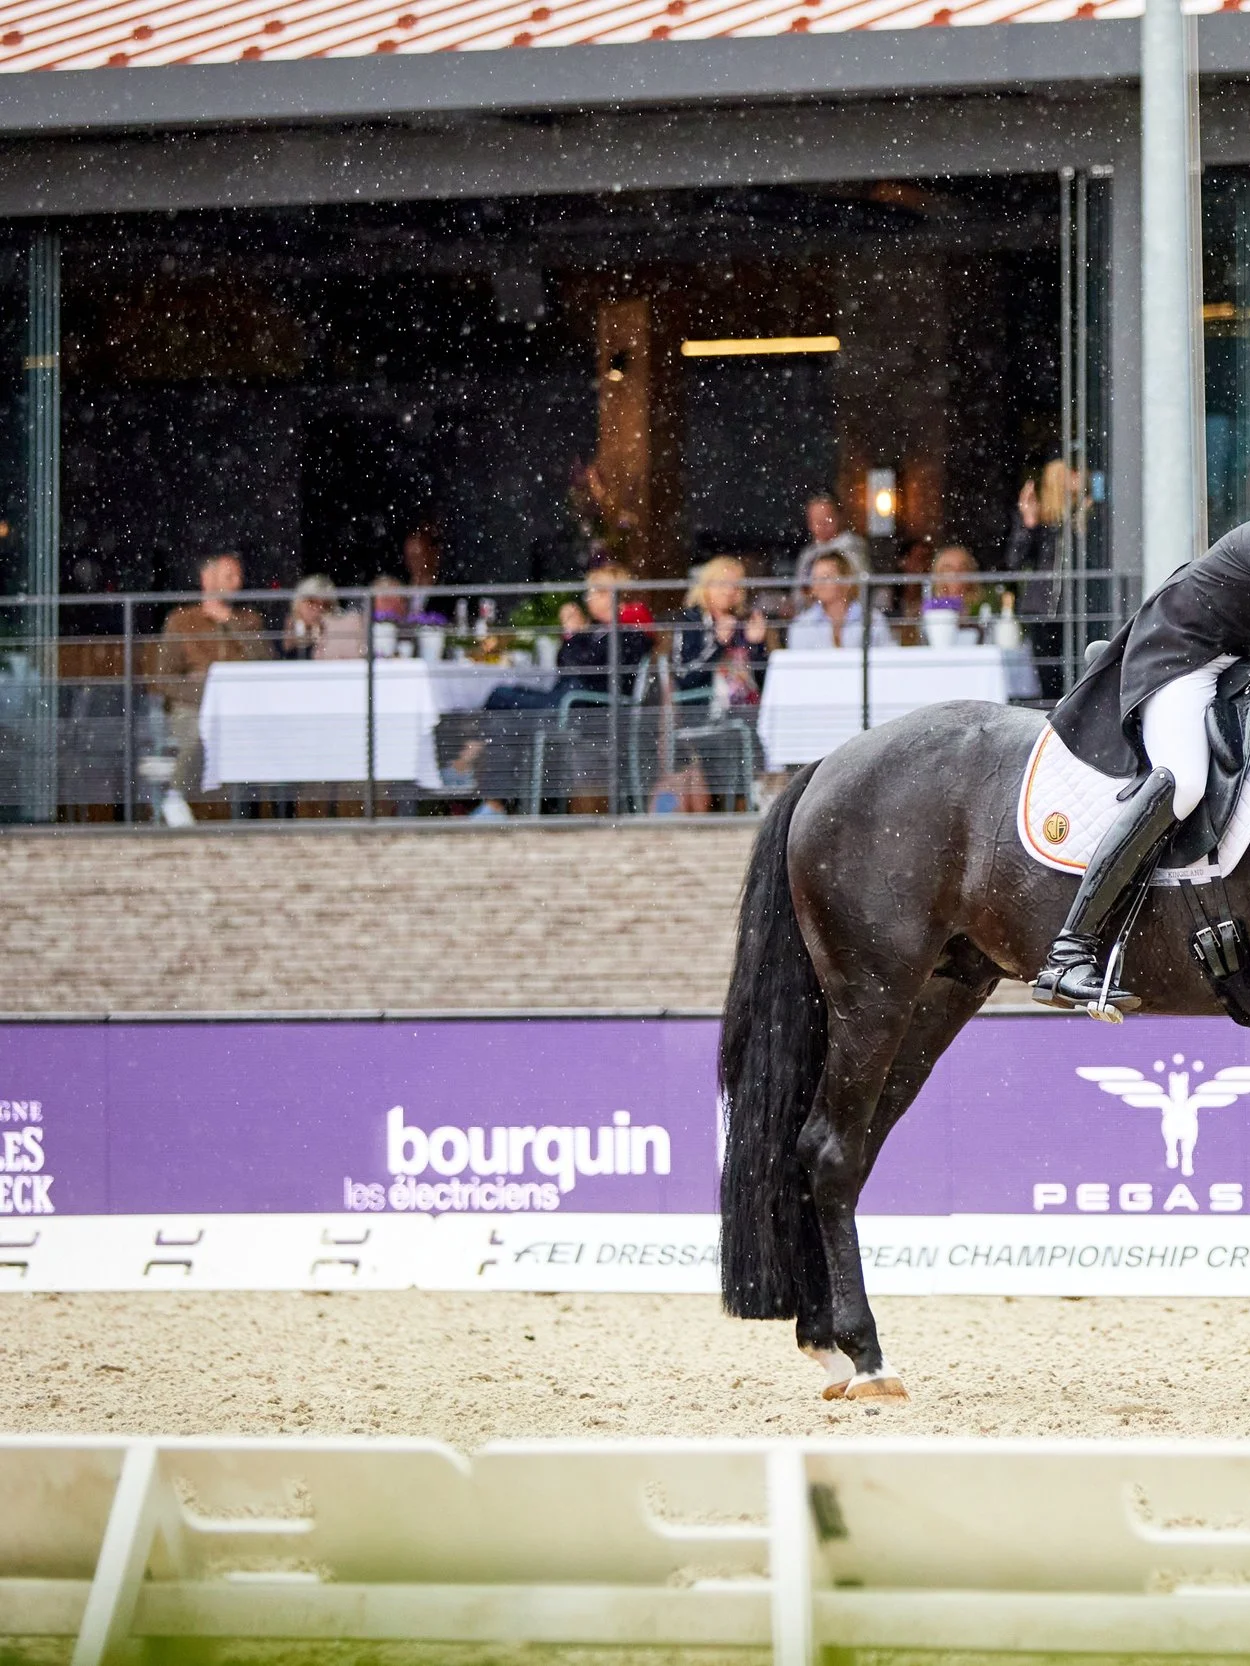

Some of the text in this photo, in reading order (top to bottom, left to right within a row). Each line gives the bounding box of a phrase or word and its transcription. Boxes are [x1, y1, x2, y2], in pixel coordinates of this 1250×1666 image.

[387, 1105, 671, 1193] bourquin
[343, 1174, 560, 1211] les électriciens
[513, 1241, 586, 1265] FEI
[595, 1243, 719, 1267] DRESSA
[859, 1244, 939, 1268] PEAN
[948, 1244, 1198, 1268] CHAMPIONSHIP
